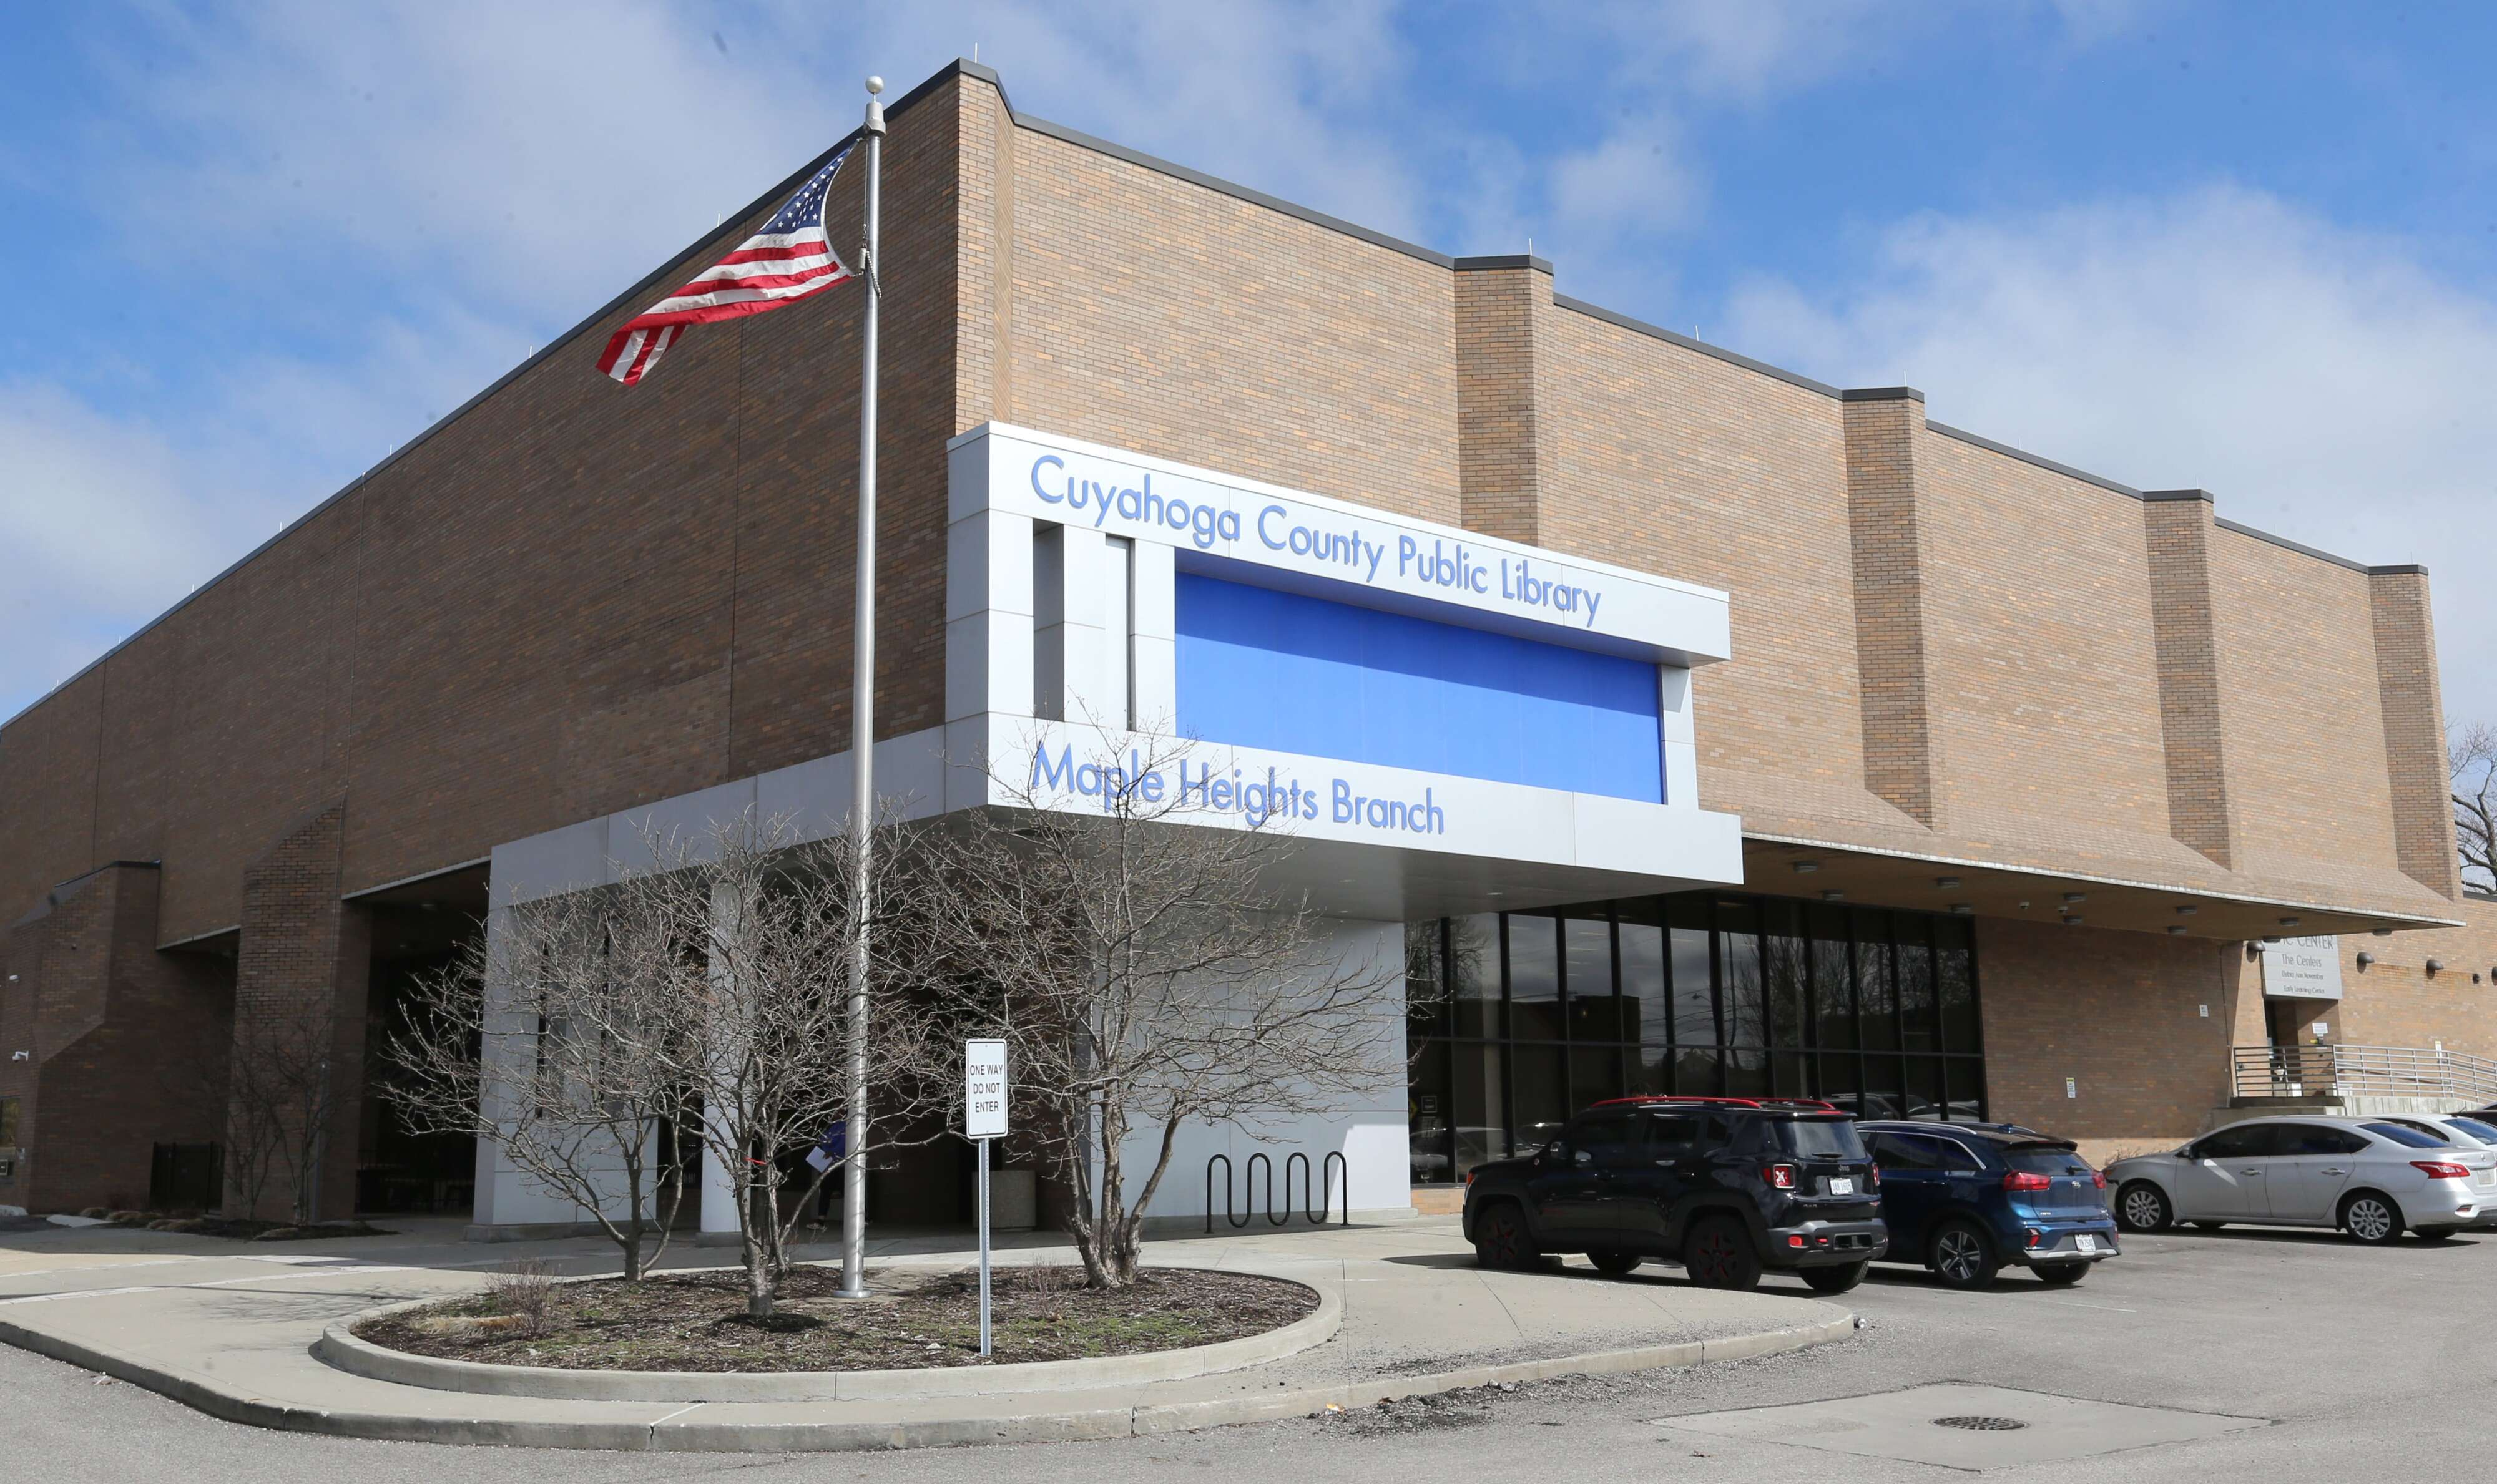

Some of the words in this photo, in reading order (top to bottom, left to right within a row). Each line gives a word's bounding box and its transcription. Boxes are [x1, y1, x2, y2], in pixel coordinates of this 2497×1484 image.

[1031, 455, 1241, 549] Cuyahoga
[1258, 505, 1385, 582] County
[1399, 535, 1488, 593] Public
[1501, 559, 1601, 628] Library
[1033, 741, 1164, 812] Maple
[1180, 759, 1318, 827] Heights
[1332, 778, 1445, 834] Branch
[2297, 935, 2333, 949] CENTER
[2282, 954, 2294, 965] The
[970, 1065, 984, 1076] ONE
[987, 1064, 1003, 1075] WAY
[973, 1083, 984, 1094] DO
[986, 1083, 1000, 1093] NOT
[975, 1101, 999, 1113] ENTER
